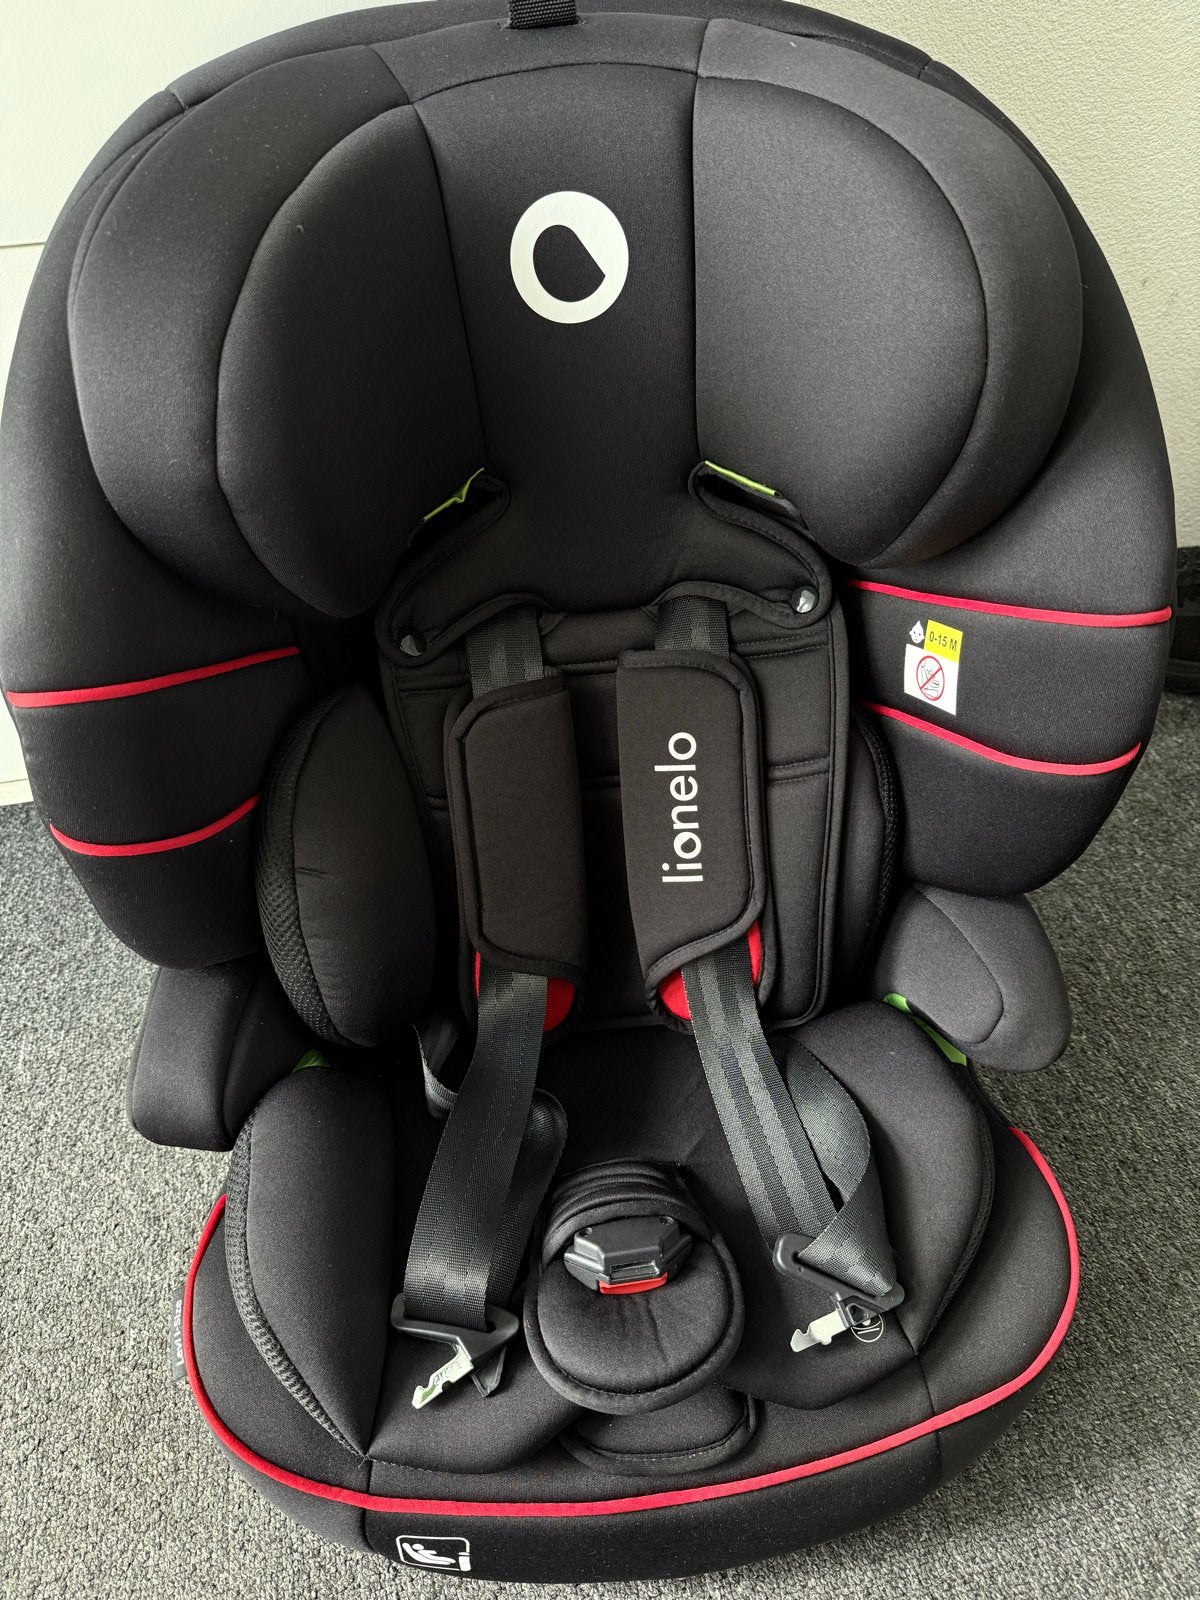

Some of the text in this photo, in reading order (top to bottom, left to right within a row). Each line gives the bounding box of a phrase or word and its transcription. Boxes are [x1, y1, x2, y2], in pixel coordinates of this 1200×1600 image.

[929, 631, 958, 652] 0-15 M
[654, 732, 704, 882] lionelo
